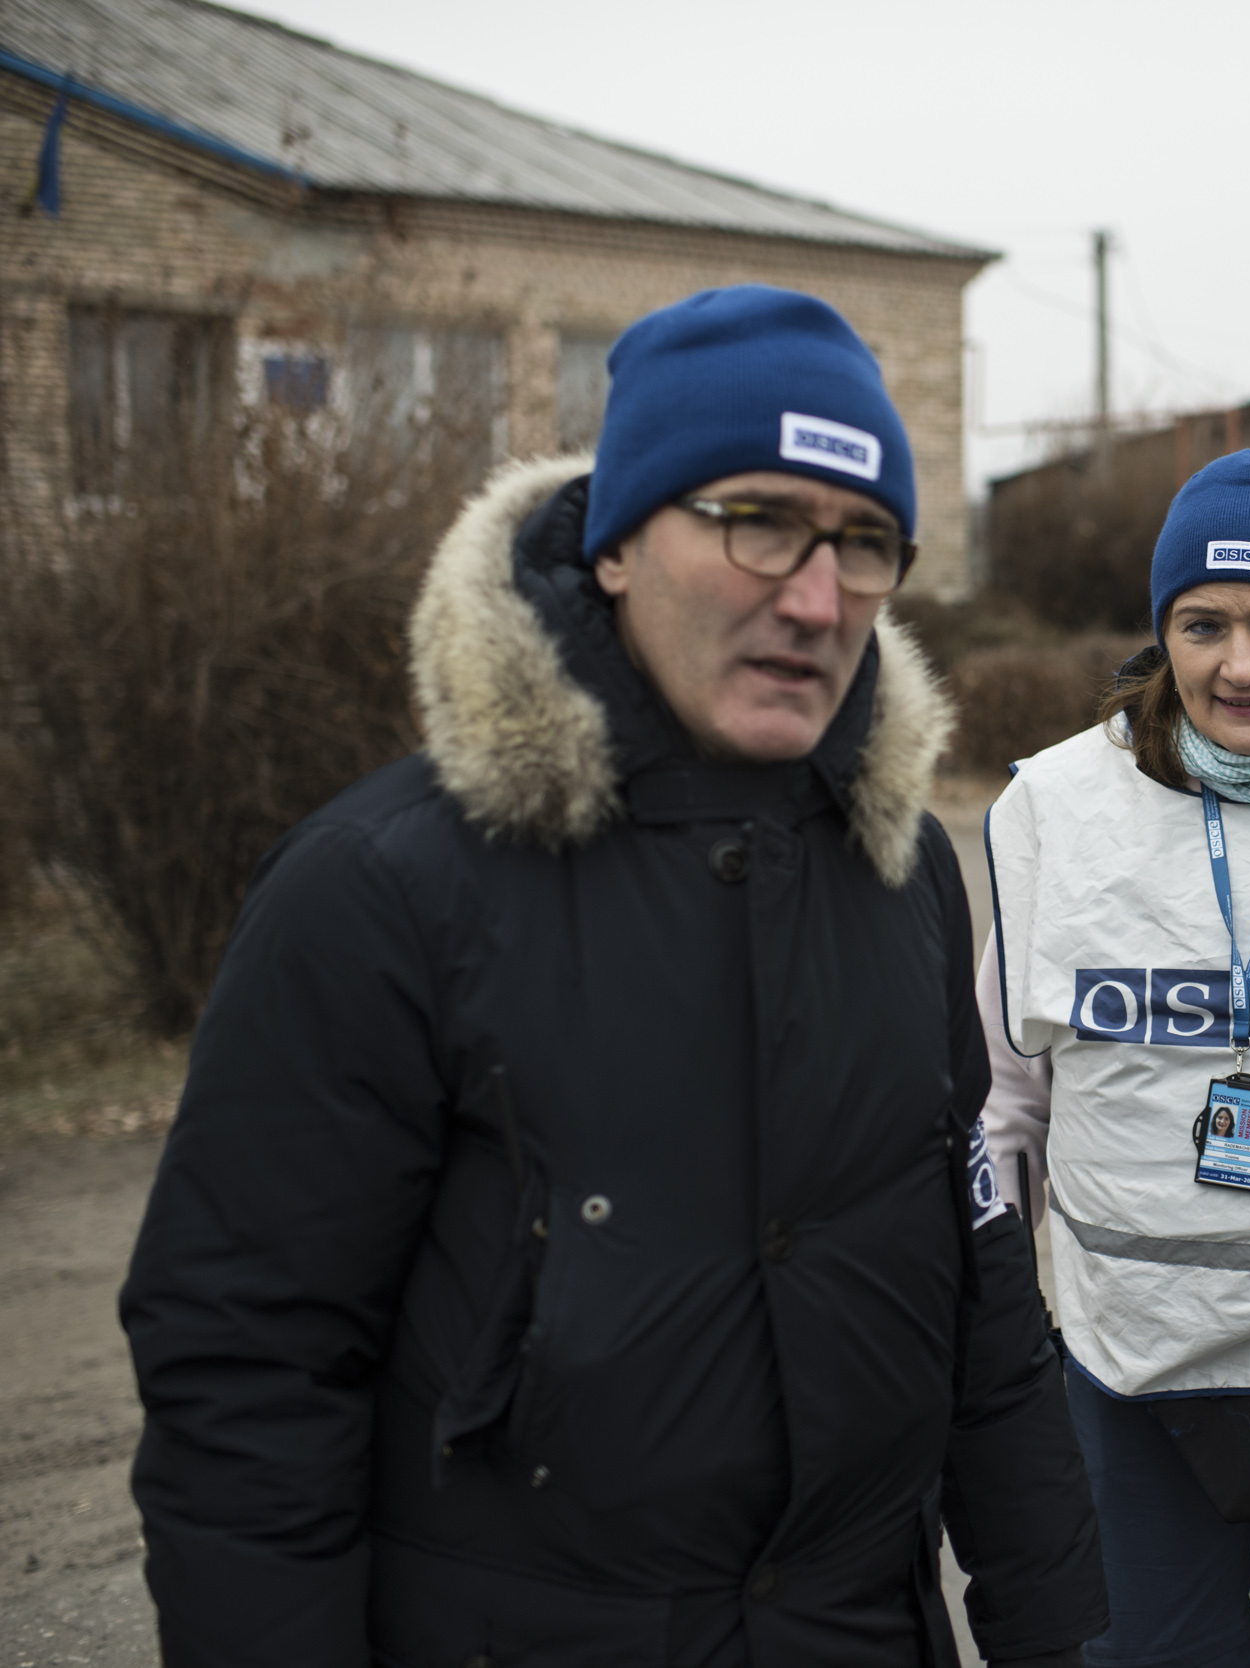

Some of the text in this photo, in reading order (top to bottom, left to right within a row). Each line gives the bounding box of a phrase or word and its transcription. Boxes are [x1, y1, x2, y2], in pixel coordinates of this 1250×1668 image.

[1209, 821, 1223, 858] osce
[1234, 966, 1244, 1008] osce
[1213, 1095, 1240, 1105] osce
[1238, 1109, 1247, 1138] MISSION
